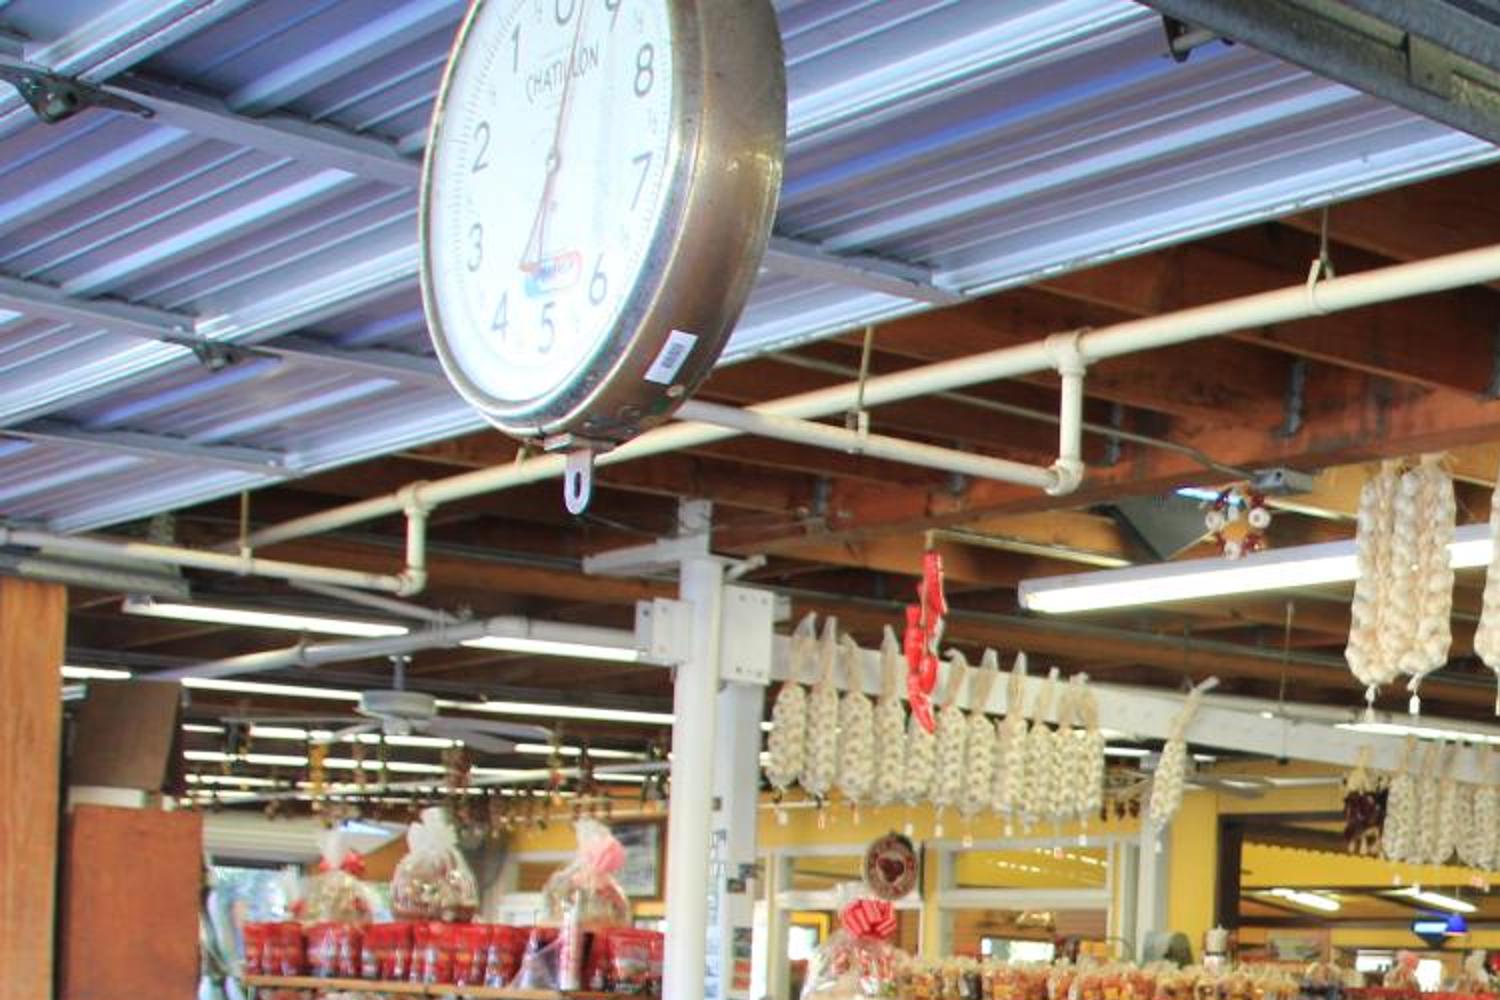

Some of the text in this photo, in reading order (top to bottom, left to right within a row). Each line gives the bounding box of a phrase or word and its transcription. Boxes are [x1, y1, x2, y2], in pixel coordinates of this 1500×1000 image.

[511, 23, 521, 74] 1
[634, 42, 654, 98] 8
[472, 121, 492, 174] 2
[630, 151, 653, 211] 7
[467, 223, 484, 272] 3
[588, 251, 608, 306] 6
[491, 292, 509, 341] 4
[538, 302, 557, 354] 5
